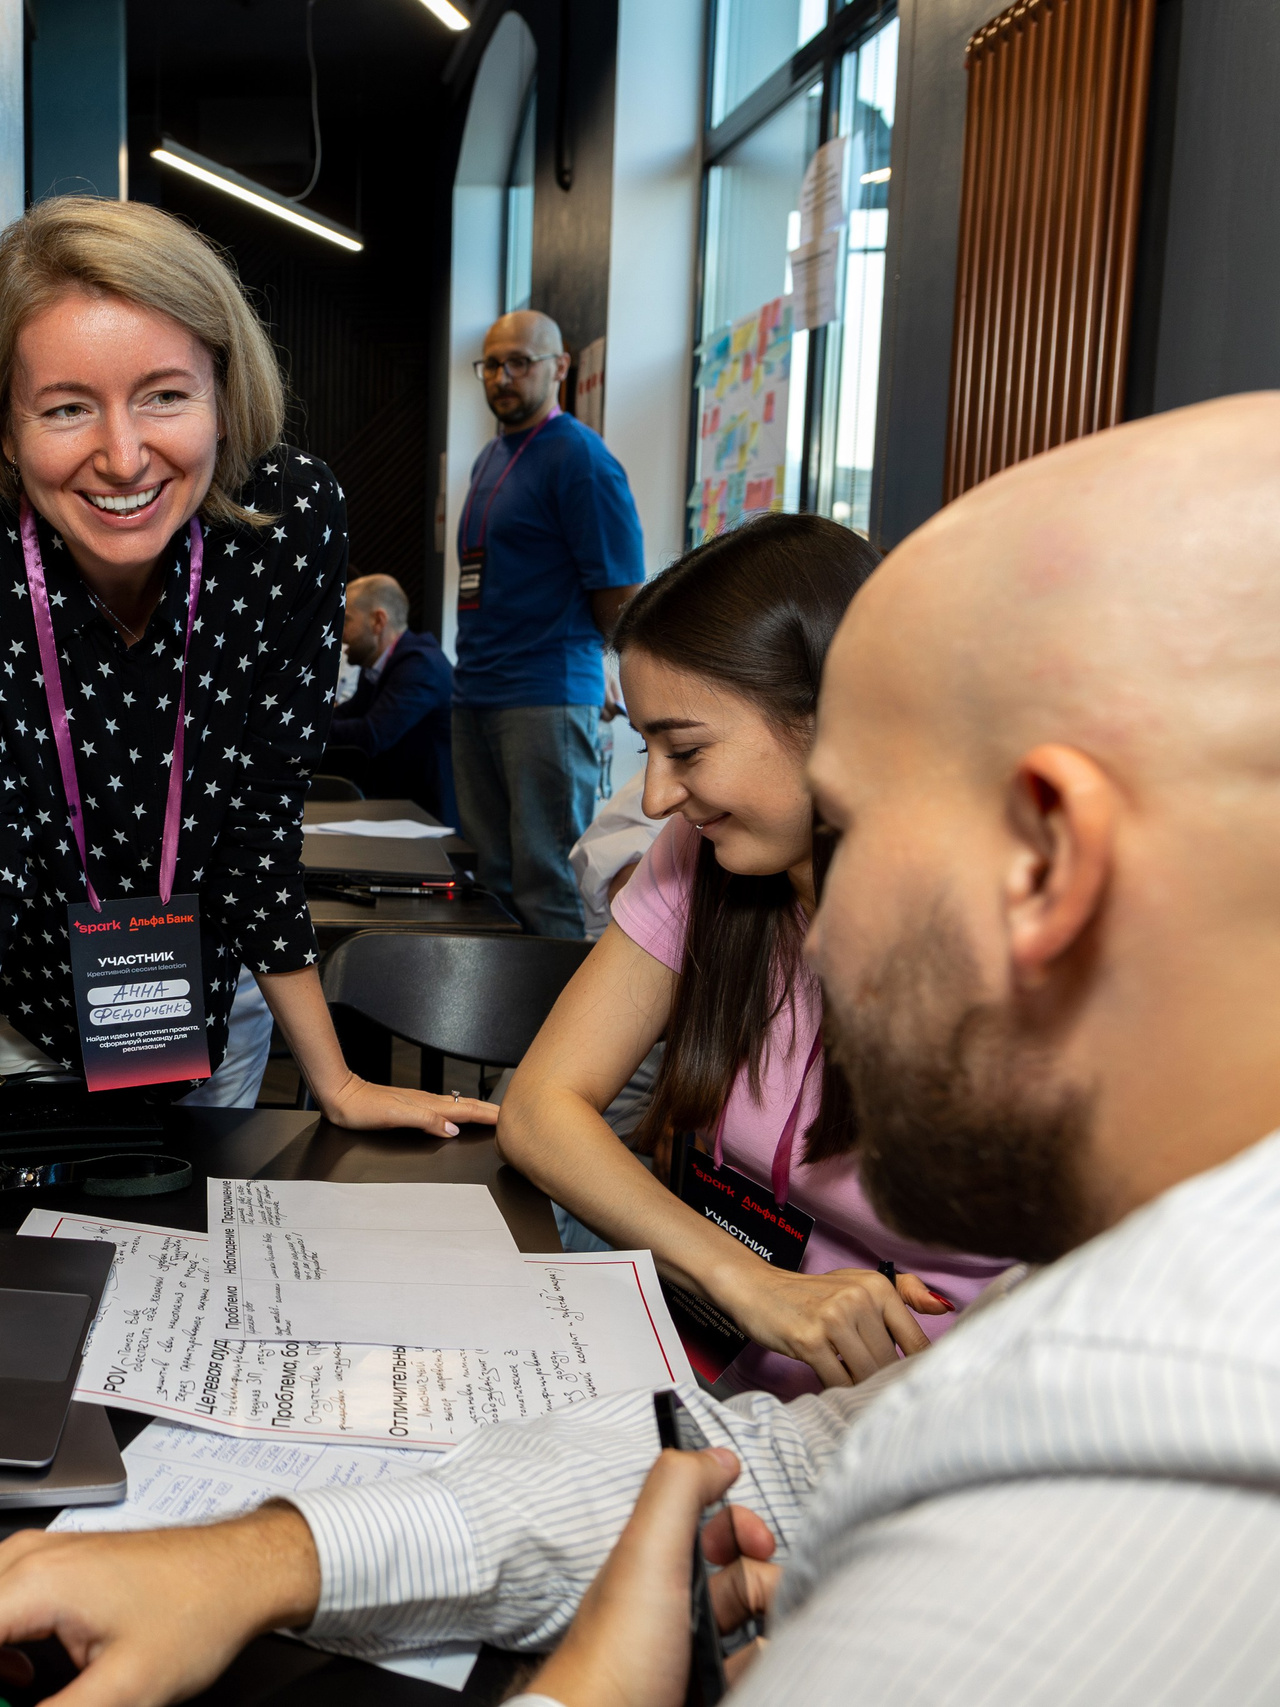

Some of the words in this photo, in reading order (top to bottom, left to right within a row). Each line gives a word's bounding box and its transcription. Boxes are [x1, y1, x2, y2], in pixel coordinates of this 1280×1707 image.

[78, 920, 121, 934] spark
[129, 915, 165, 930] Альфа
[166, 913, 194, 925] Банк
[86, 967, 131, 978] Креативной
[158, 962, 187, 971] Ideation
[98, 951, 175, 968] УЧАСТНИК
[112, 980, 170, 1003] АННА
[93, 1001, 192, 1023] ФЕДОРЧЕНКО
[86, 1035, 110, 1043] Найди
[110, 1033, 129, 1041] идею
[135, 1028, 169, 1038] прототип
[99, 1038, 142, 1049] сформируй
[143, 1035, 173, 1045] команду
[173, 1033, 188, 1041] для
[122, 1042, 166, 1054] реализации
[695, 1167, 736, 1198] spark
[221, 1180, 235, 1225] Предложение
[741, 1195, 777, 1223] Альфа
[777, 1216, 805, 1243] Банк
[704, 1206, 774, 1262] УЧАСТНИК
[222, 1228, 237, 1275] Наблюдение
[223, 1284, 240, 1330] Проблема
[103, 1365, 128, 1394] POV
[194, 1361, 223, 1416] Целевая
[271, 1360, 300, 1428] Проблема,
[299, 1364, 333, 1425] Отсутствие
